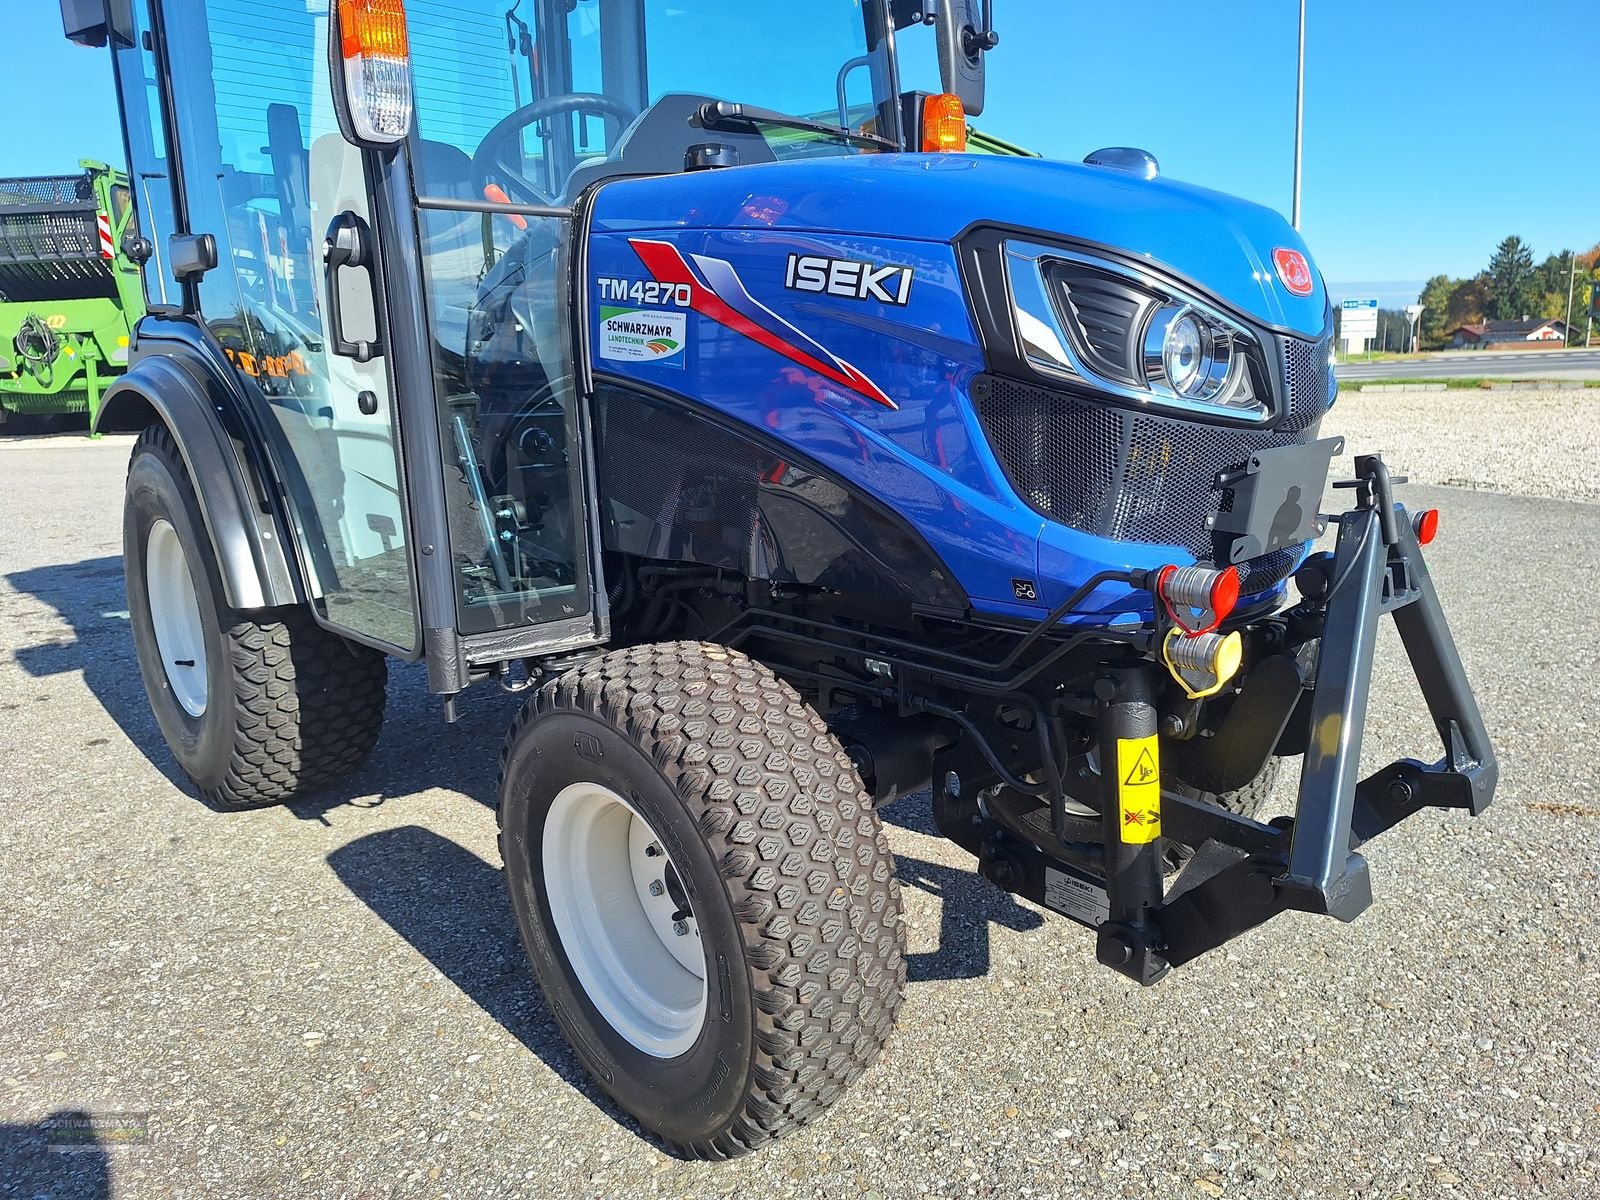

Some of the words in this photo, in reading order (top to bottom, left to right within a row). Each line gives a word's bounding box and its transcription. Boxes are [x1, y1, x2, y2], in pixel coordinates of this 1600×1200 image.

[785, 253, 914, 305] ISEKI
[597, 278, 692, 307] TM4270
[607, 320, 672, 337] SCHWARZMAYR
[608, 335, 645, 346] LANDTECHNIK
[1071, 880, 1094, 894] ISEKI
